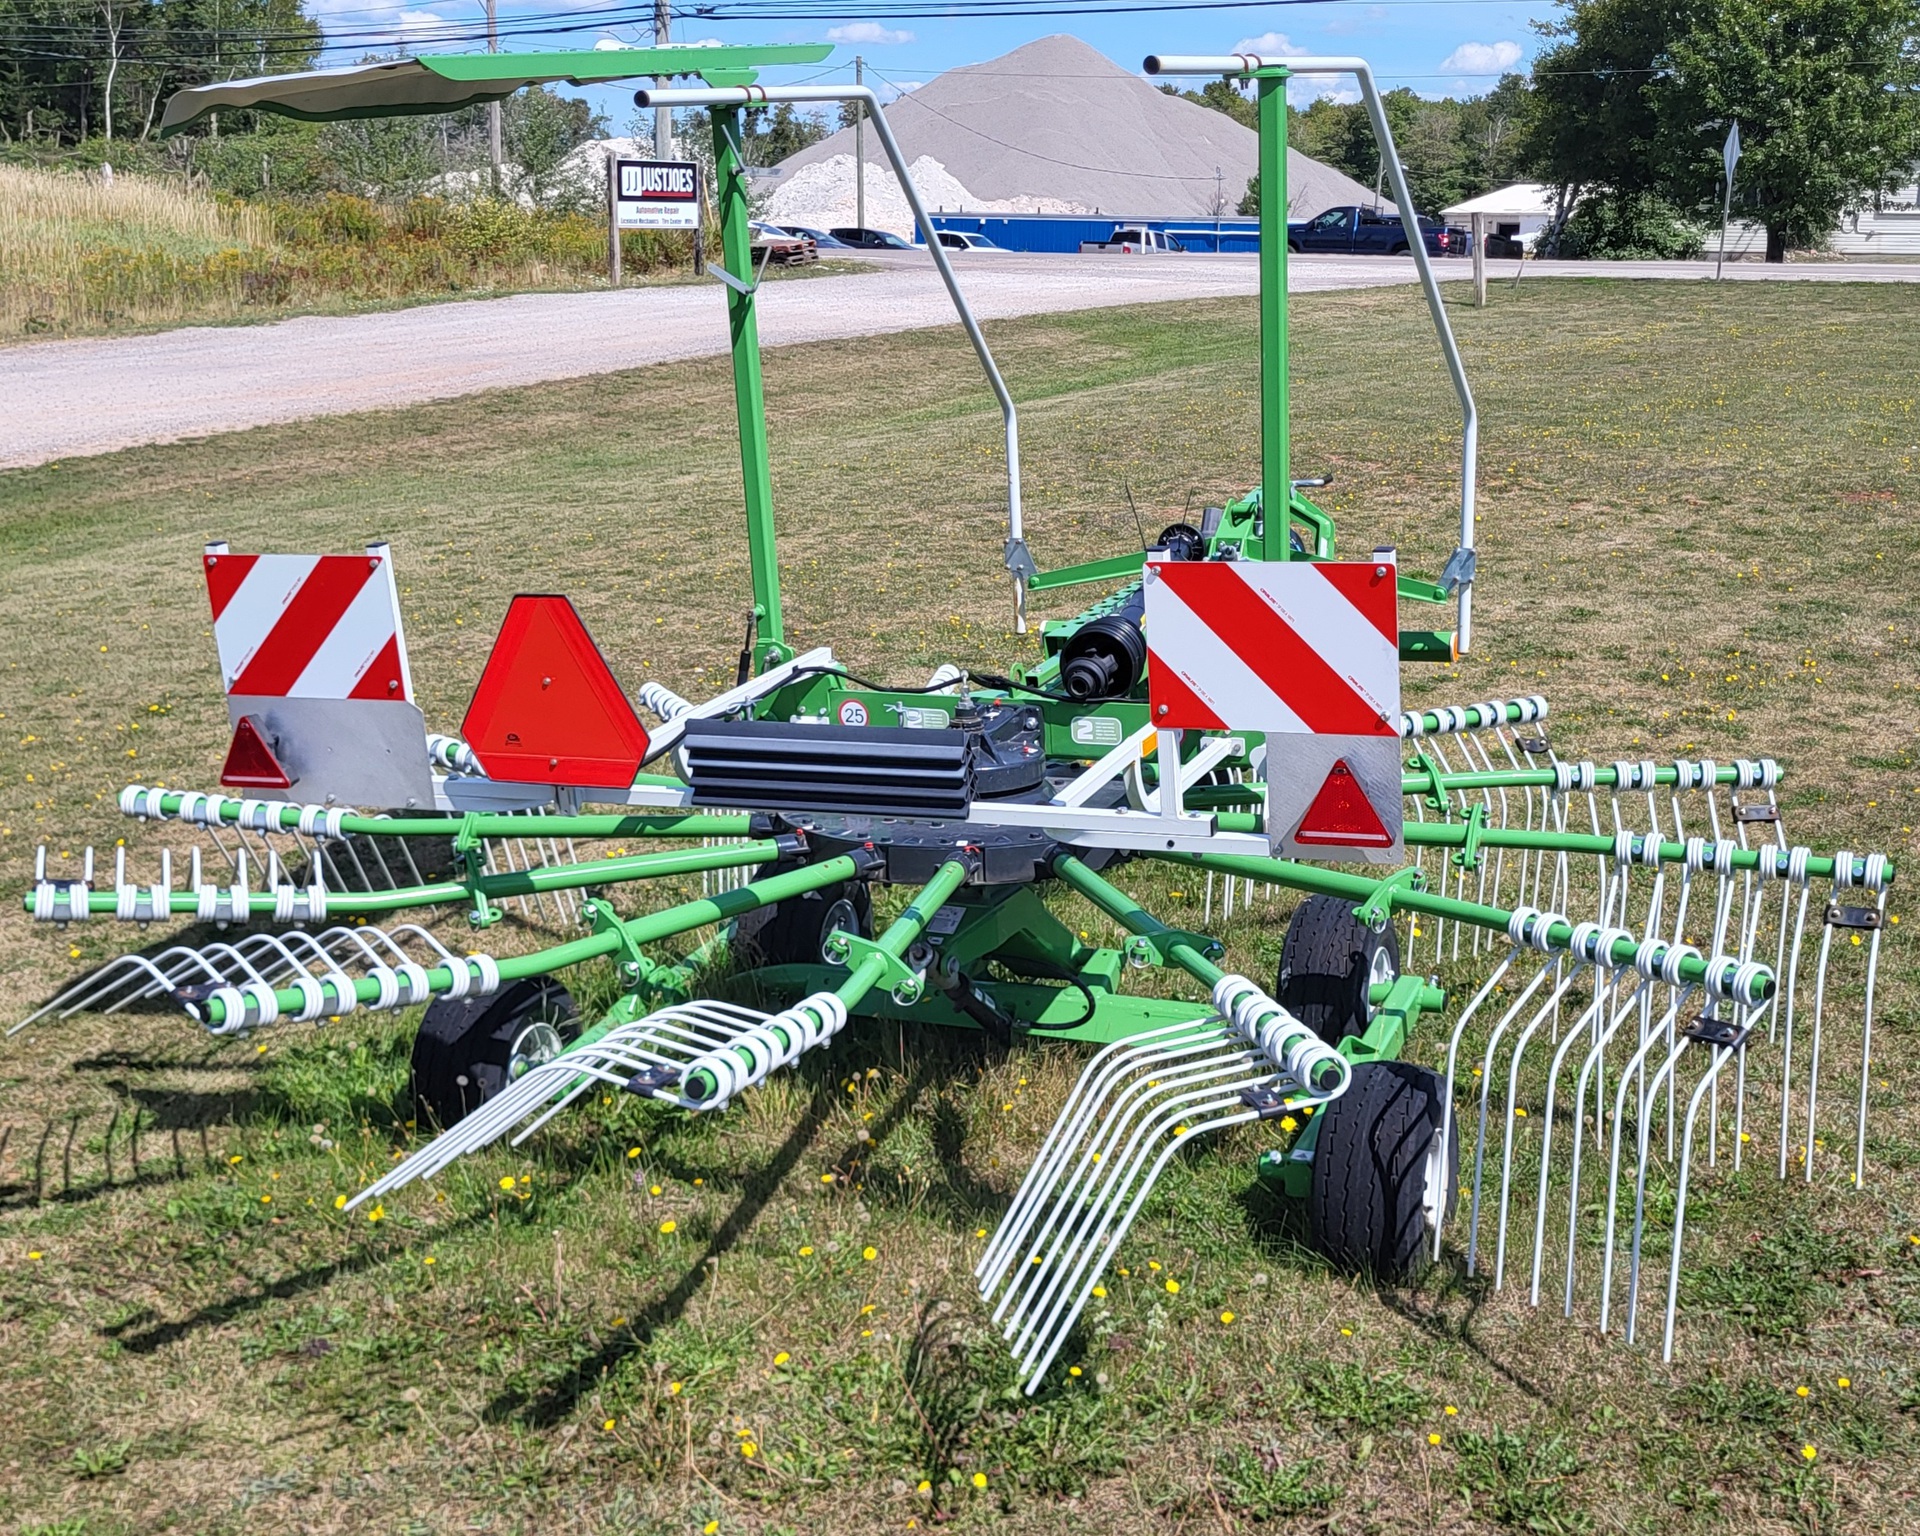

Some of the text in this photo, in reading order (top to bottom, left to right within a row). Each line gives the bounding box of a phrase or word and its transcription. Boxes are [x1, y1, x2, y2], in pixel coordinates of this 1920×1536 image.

[642, 167, 693, 192] JUSTJOES
[636, 206, 679, 214] Automotive Repair
[844, 708, 864, 723] 25
[1077, 720, 1093, 740] 2
